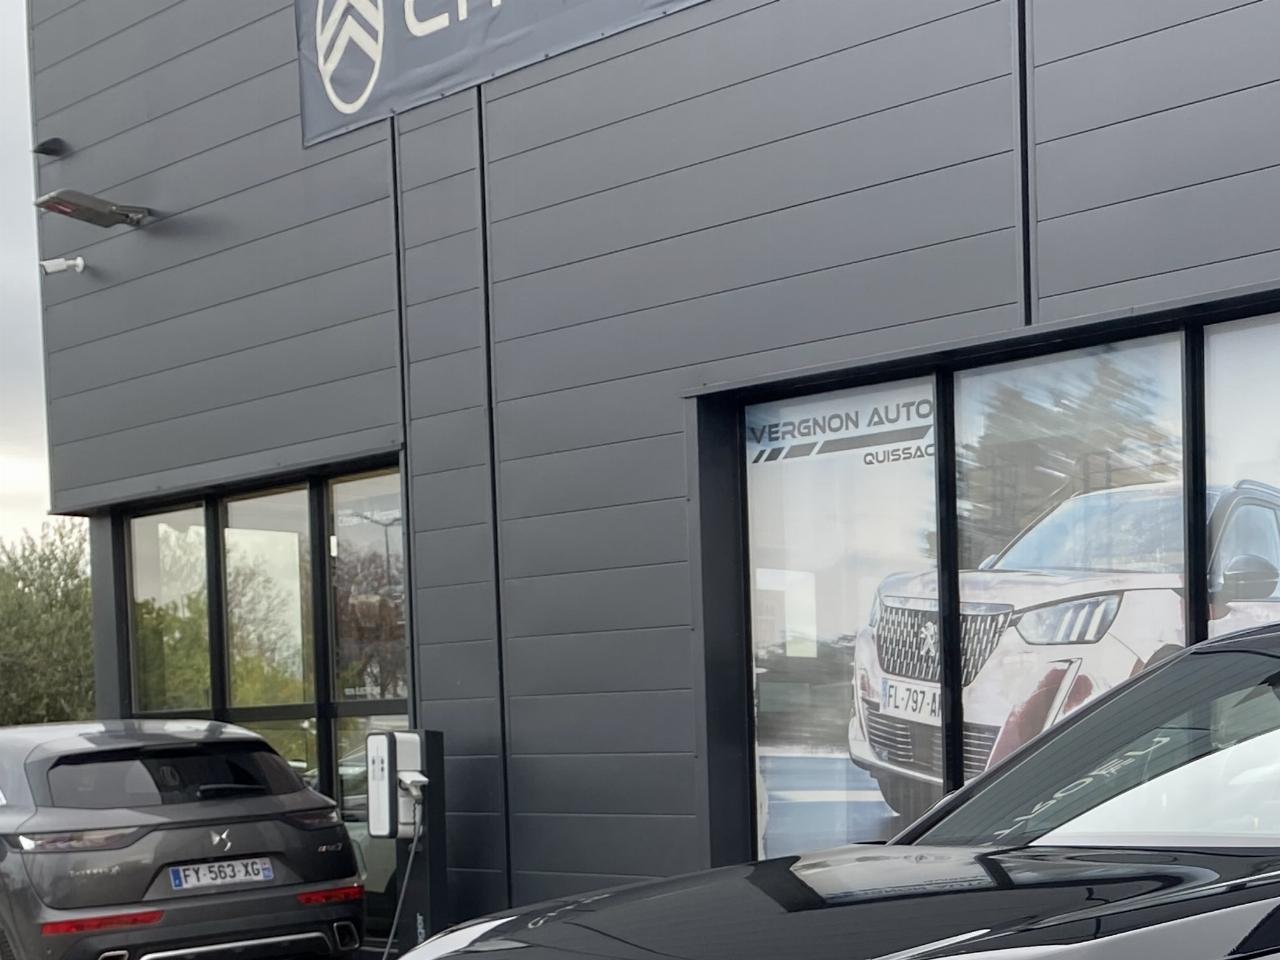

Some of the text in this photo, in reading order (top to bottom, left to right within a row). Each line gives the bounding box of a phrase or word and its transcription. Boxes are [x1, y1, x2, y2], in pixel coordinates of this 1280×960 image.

[750, 399, 933, 444] VERGNON AUTO
[864, 444, 935, 465] QUISSAC
[888, 685, 942, 718] FL-797-A
